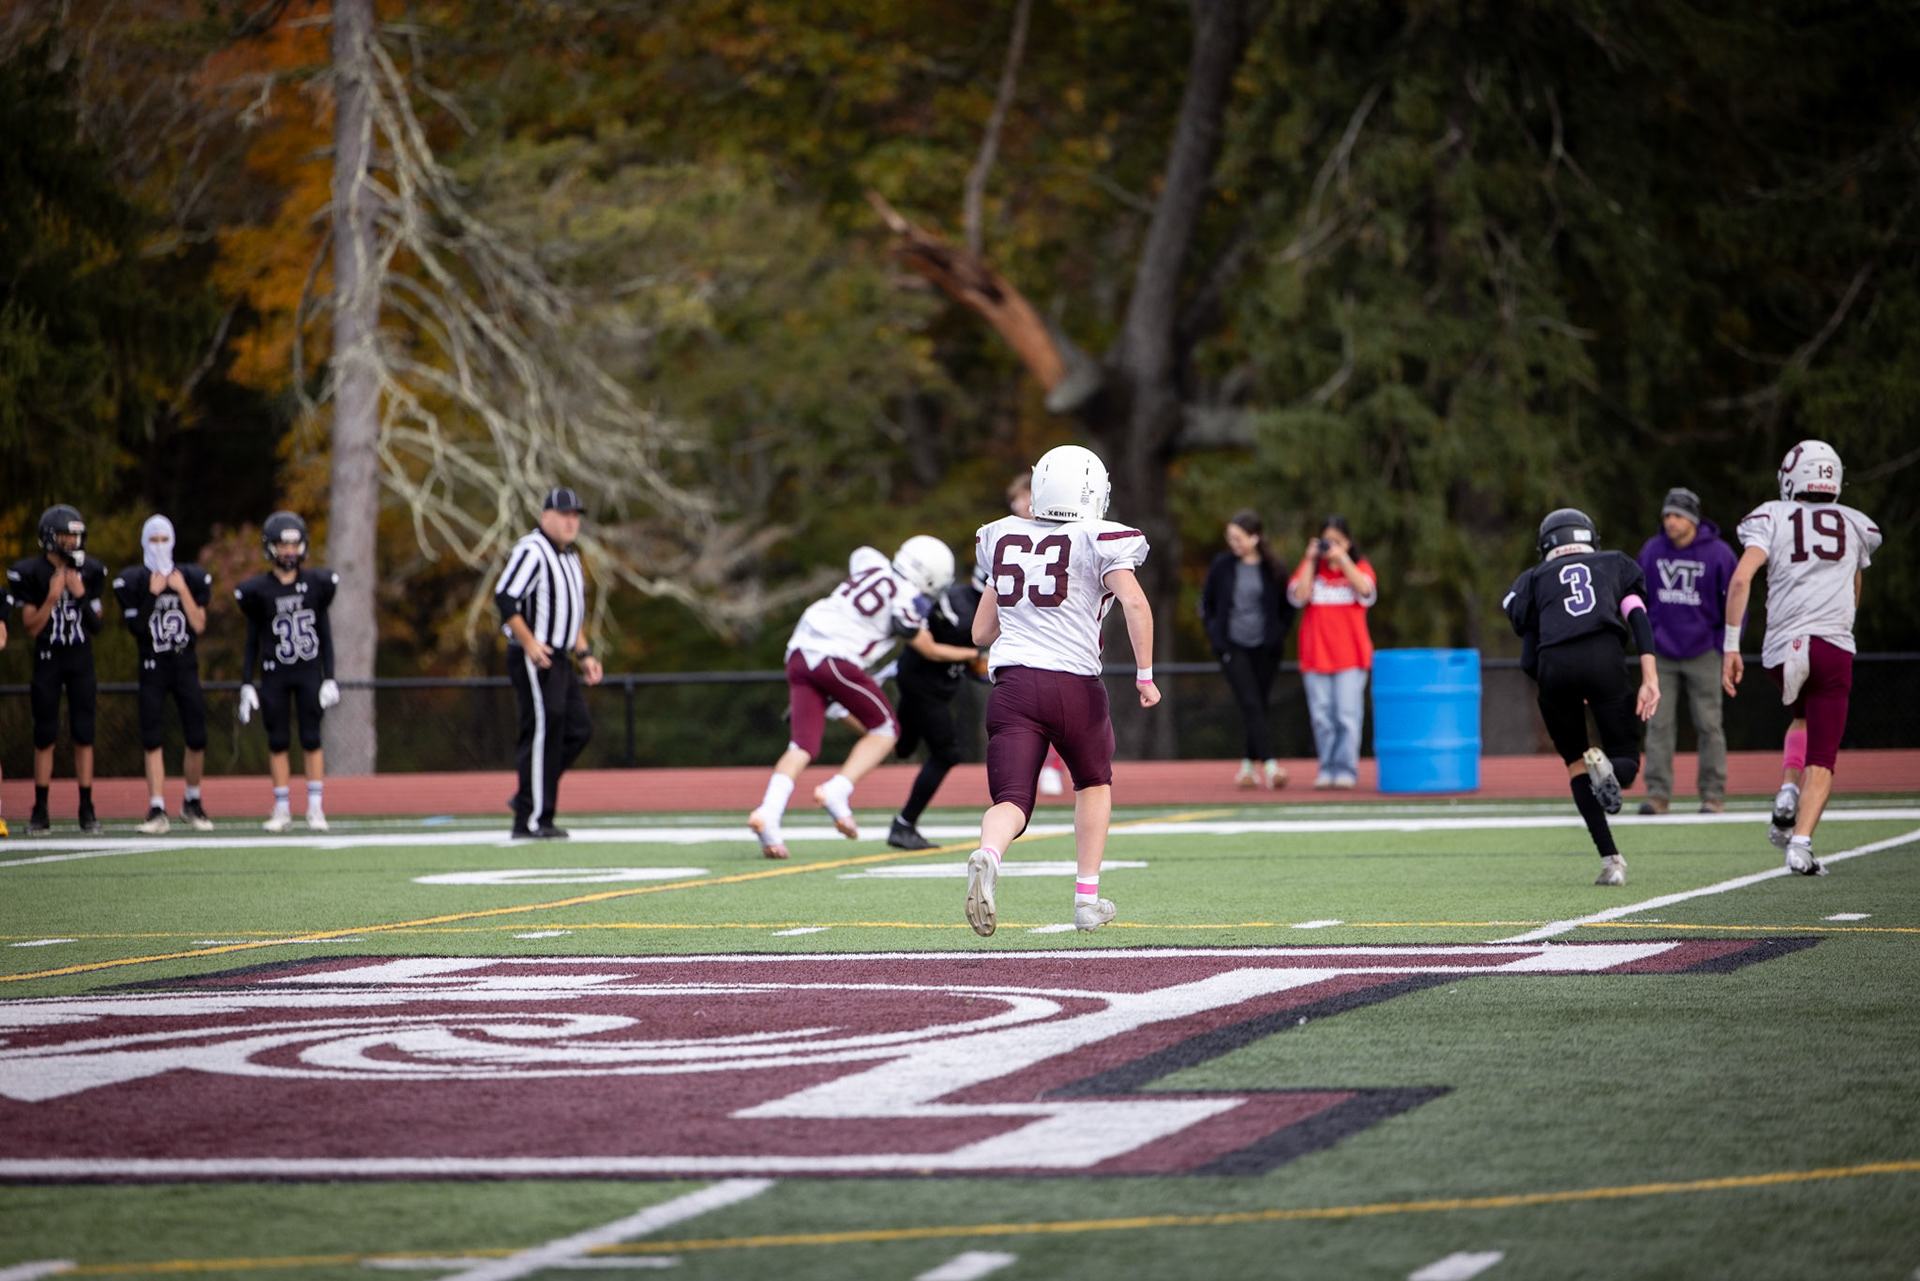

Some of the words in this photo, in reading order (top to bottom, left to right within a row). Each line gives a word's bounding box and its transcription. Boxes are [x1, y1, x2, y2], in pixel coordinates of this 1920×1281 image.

[1047, 509, 1078, 519] XENITH
[1788, 507, 1847, 563] 19
[992, 533, 1072, 608] 63
[1558, 562, 1597, 617] 3
[1656, 558, 1706, 593] VT
[271, 608, 320, 665] 35
